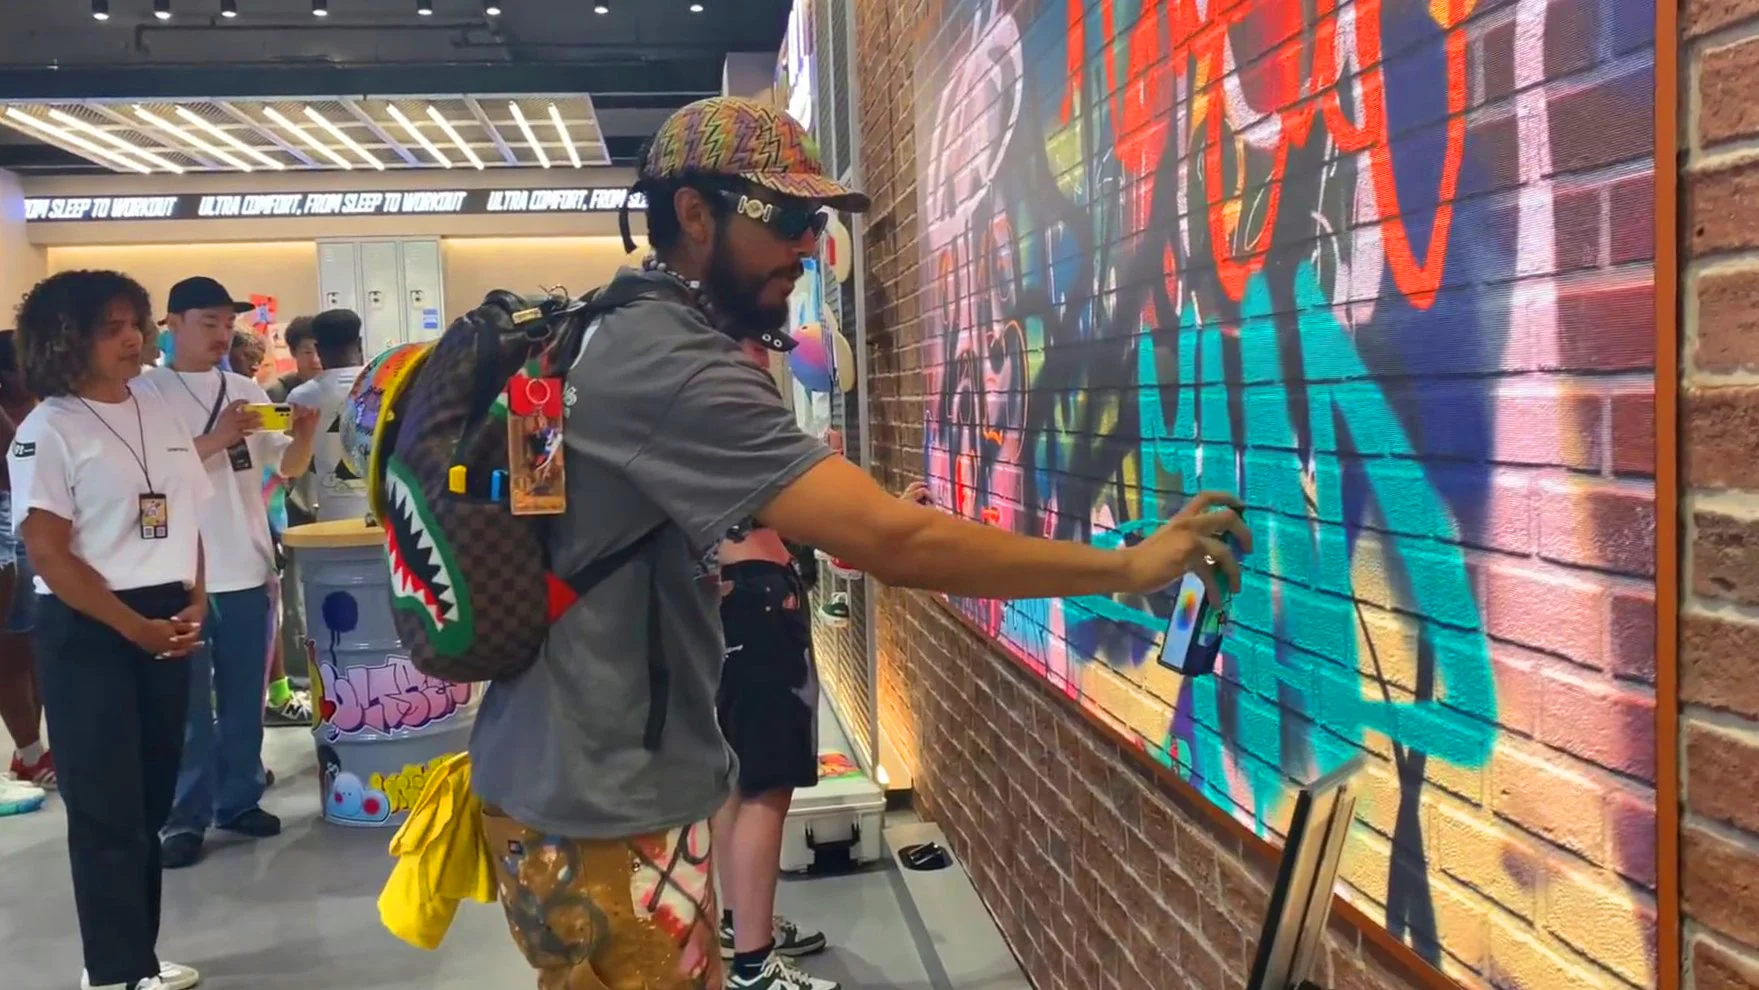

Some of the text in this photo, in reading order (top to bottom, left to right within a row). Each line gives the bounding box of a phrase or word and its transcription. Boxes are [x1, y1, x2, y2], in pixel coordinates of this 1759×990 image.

[24, 196, 178, 219] OM SLEEP TO WORKOUT
[198, 191, 468, 216] ULTRA COMFORT, FROM SLEEP TO WORKOUT
[486, 190, 529, 212] ULTRA
[528, 189, 588, 211] COMFORT,
[588, 188, 628, 210] FROM
